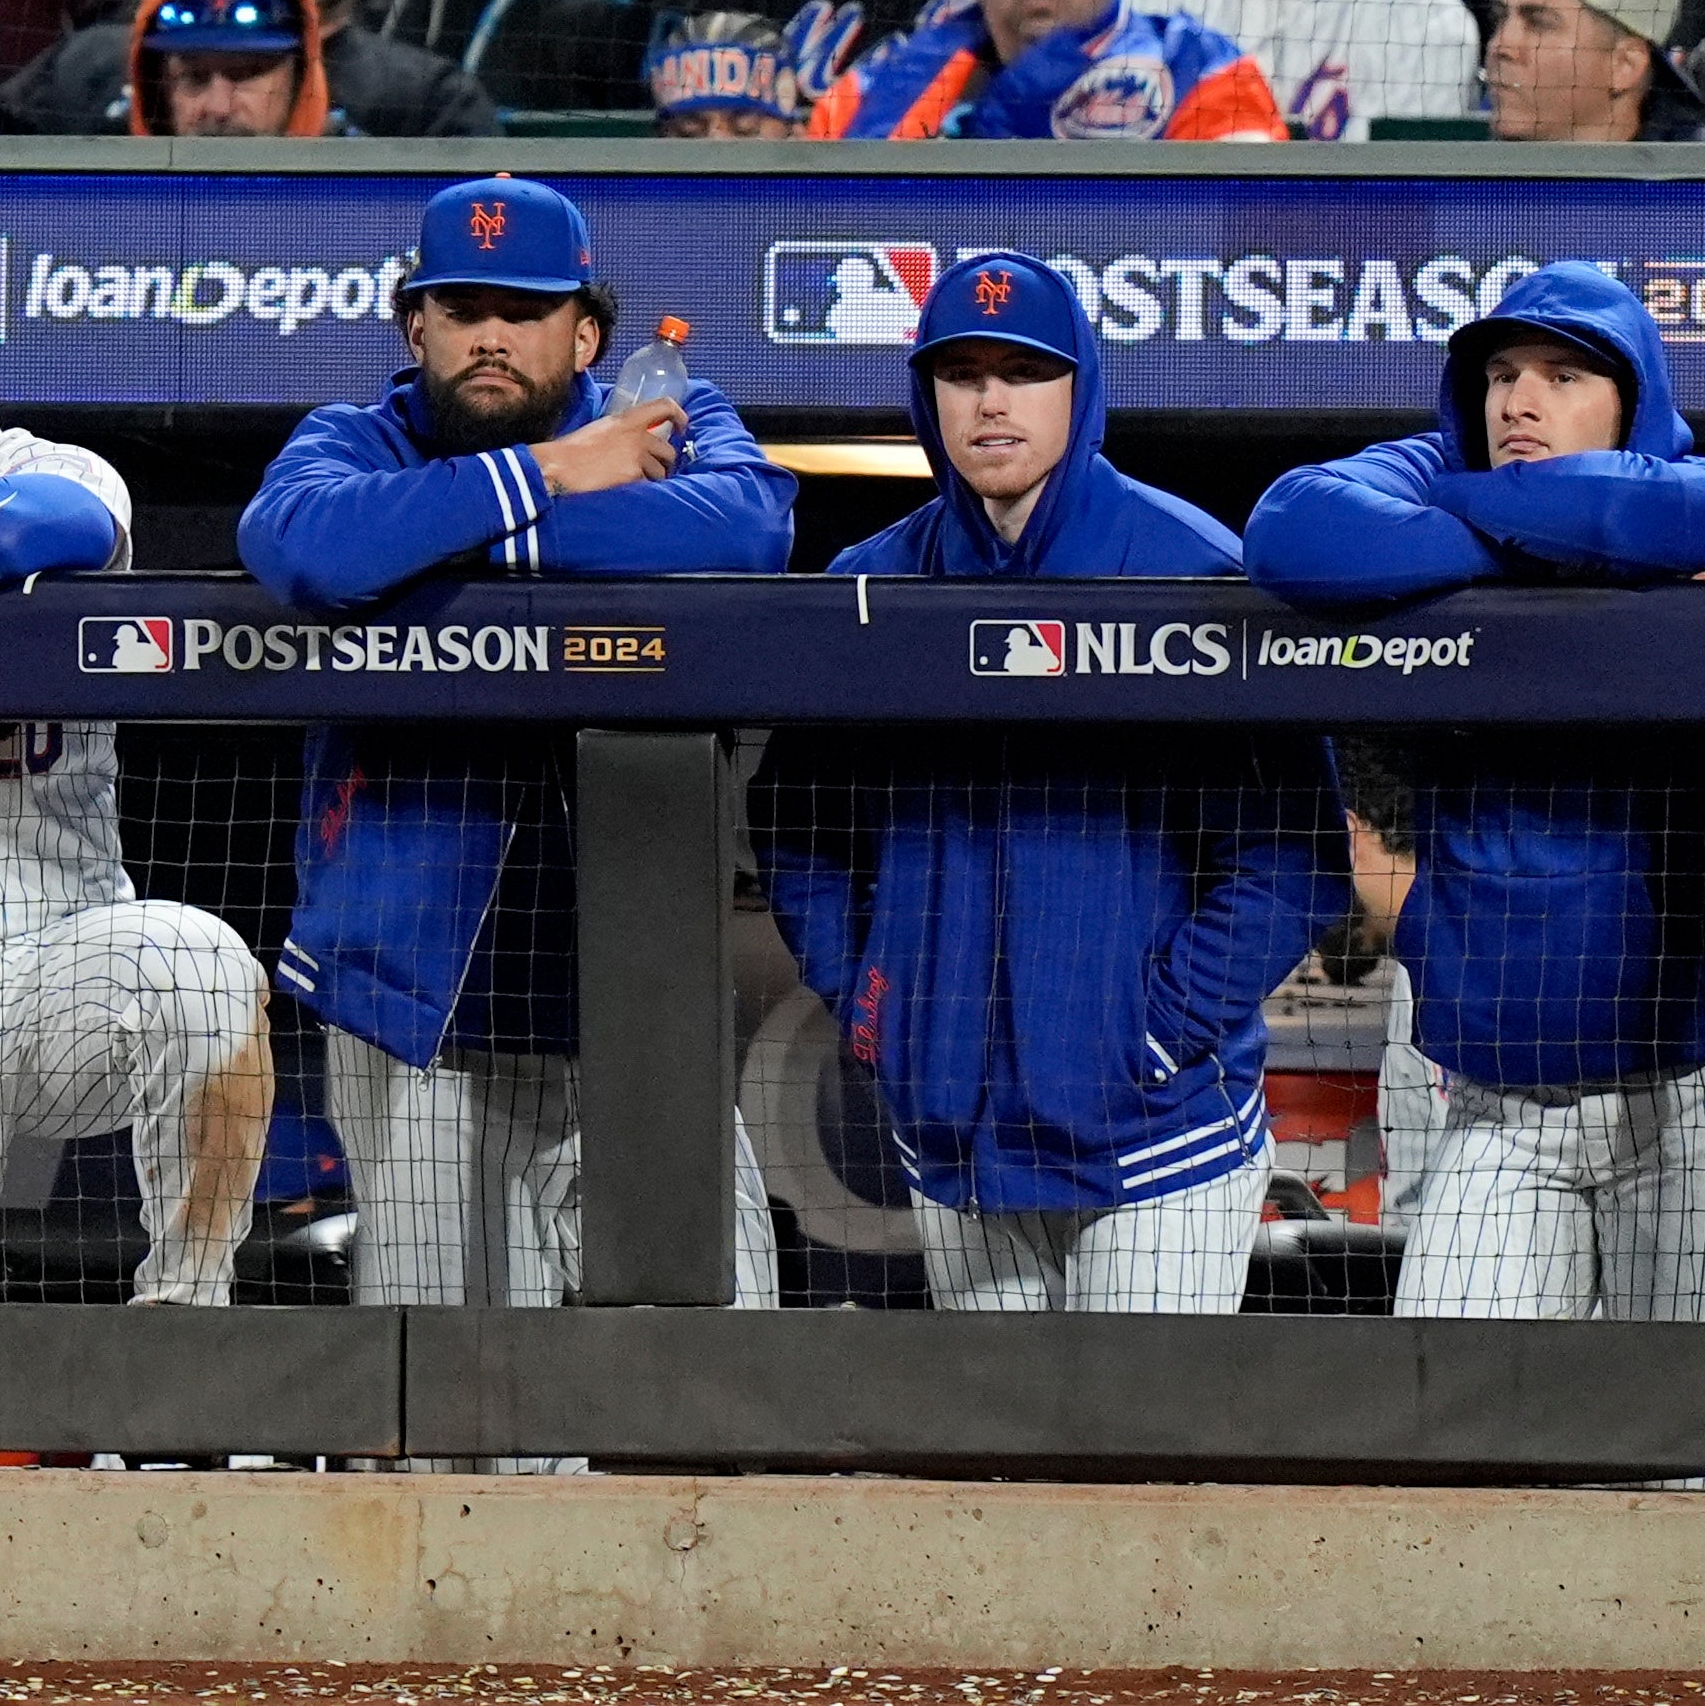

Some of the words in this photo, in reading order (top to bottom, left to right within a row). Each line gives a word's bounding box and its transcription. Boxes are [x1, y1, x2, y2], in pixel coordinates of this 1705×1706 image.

[183, 618, 550, 673] POSTSEASON
[563, 636, 666, 662] 2024
[1075, 622, 1230, 677] NLCS
[1258, 629, 1474, 676] loanDepot
